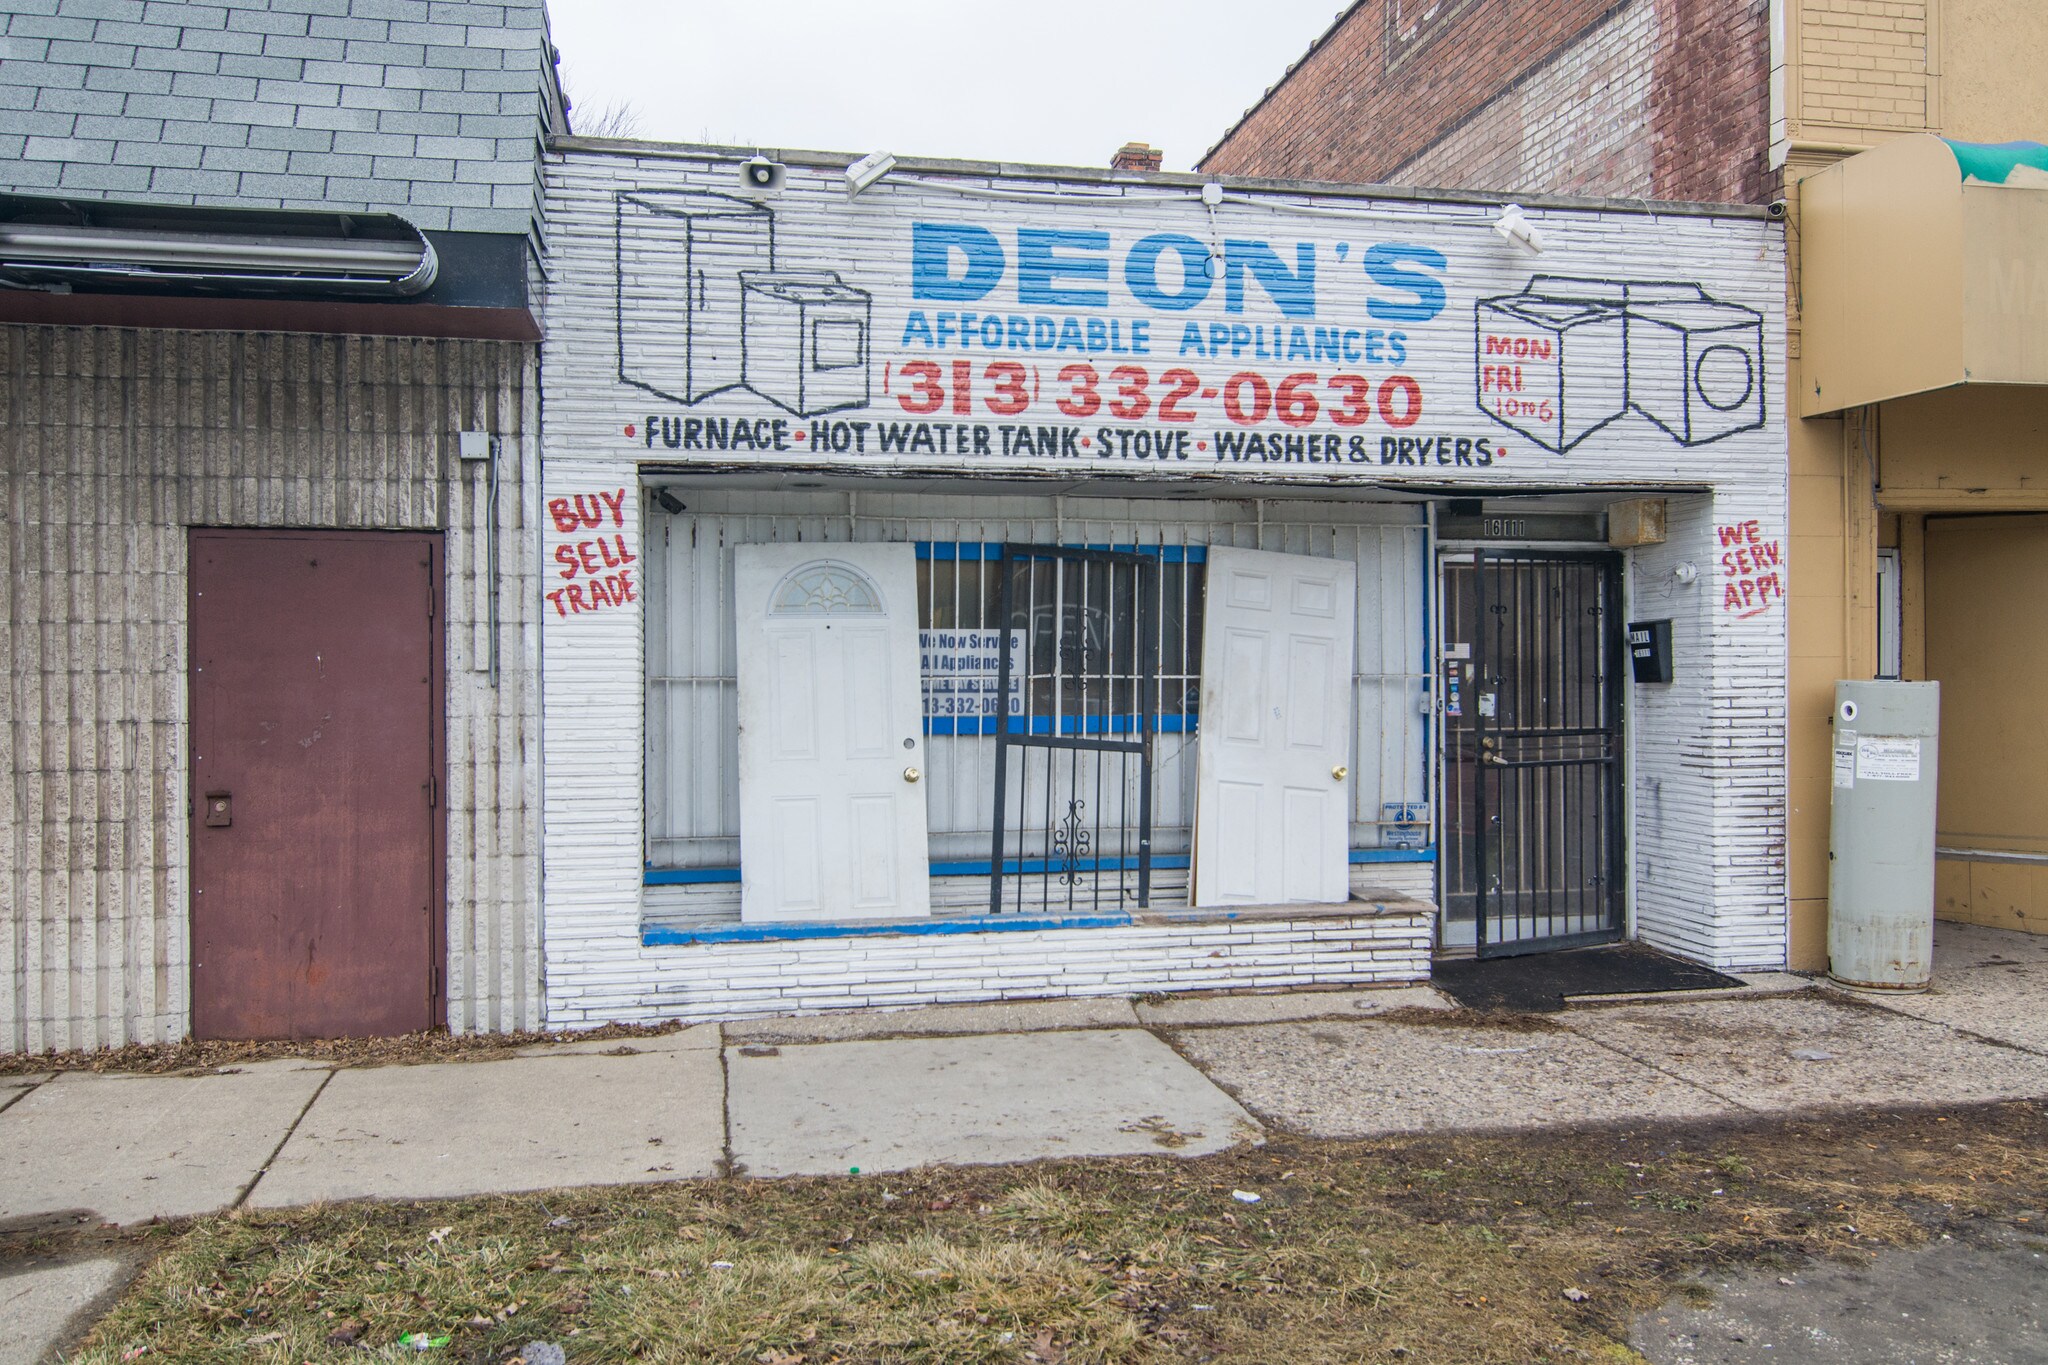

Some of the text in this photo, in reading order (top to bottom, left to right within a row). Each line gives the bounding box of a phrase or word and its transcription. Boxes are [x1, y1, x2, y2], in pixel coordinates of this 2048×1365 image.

[912, 221, 1448, 322] DEON'S
[901, 310, 1407, 367] AFFORDABLE APPLIANCES
[884, 360, 1423, 428] (313) 332-0630
[645, 416, 1493, 466] FURNACE HOT WATER TANK STOVE WASHER & DRYERS
[548, 488, 625, 533] BUY
[1484, 519, 1525, 537] 16111
[1718, 520, 1760, 548] WE
[555, 534, 637, 580] SELL
[546, 570, 638, 618] TRADE
[939, 633, 966, 648] Now
[941, 654, 1014, 671] Appliancs
[923, 697, 1020, 714] 13-332-060
